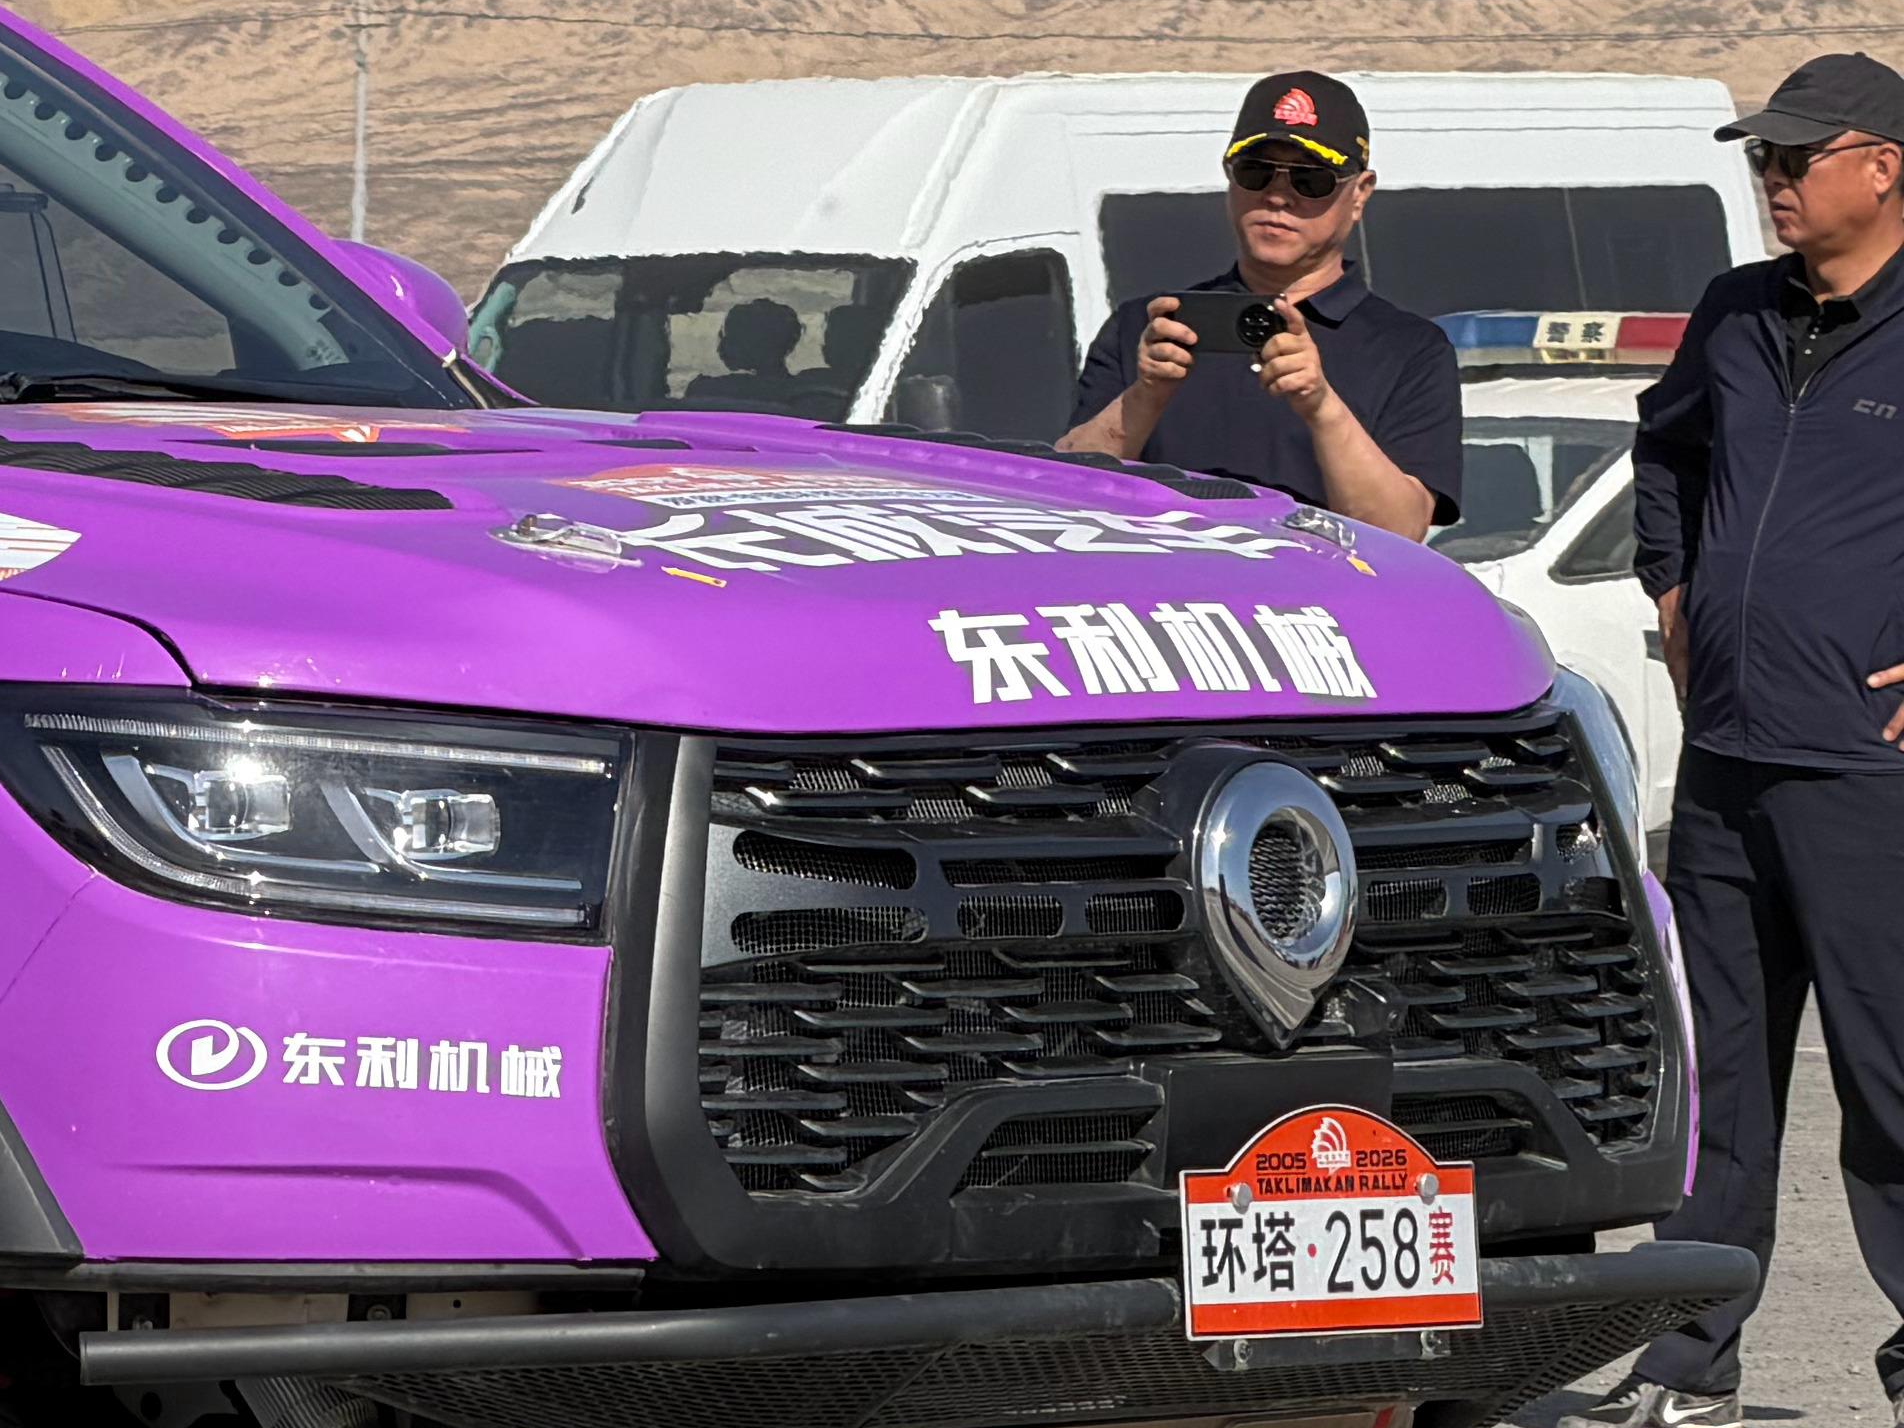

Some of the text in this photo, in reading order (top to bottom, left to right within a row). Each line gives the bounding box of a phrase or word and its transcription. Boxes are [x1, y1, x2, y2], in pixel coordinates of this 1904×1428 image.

[928, 601, 1379, 704] 东利机械
[281, 1032, 563, 1098] 东利机械
[1256, 1152, 1307, 1171] 2005
[1355, 1149, 1407, 1168] 2026
[1256, 1173, 1408, 1195] TAKLIMAKAN RALLY
